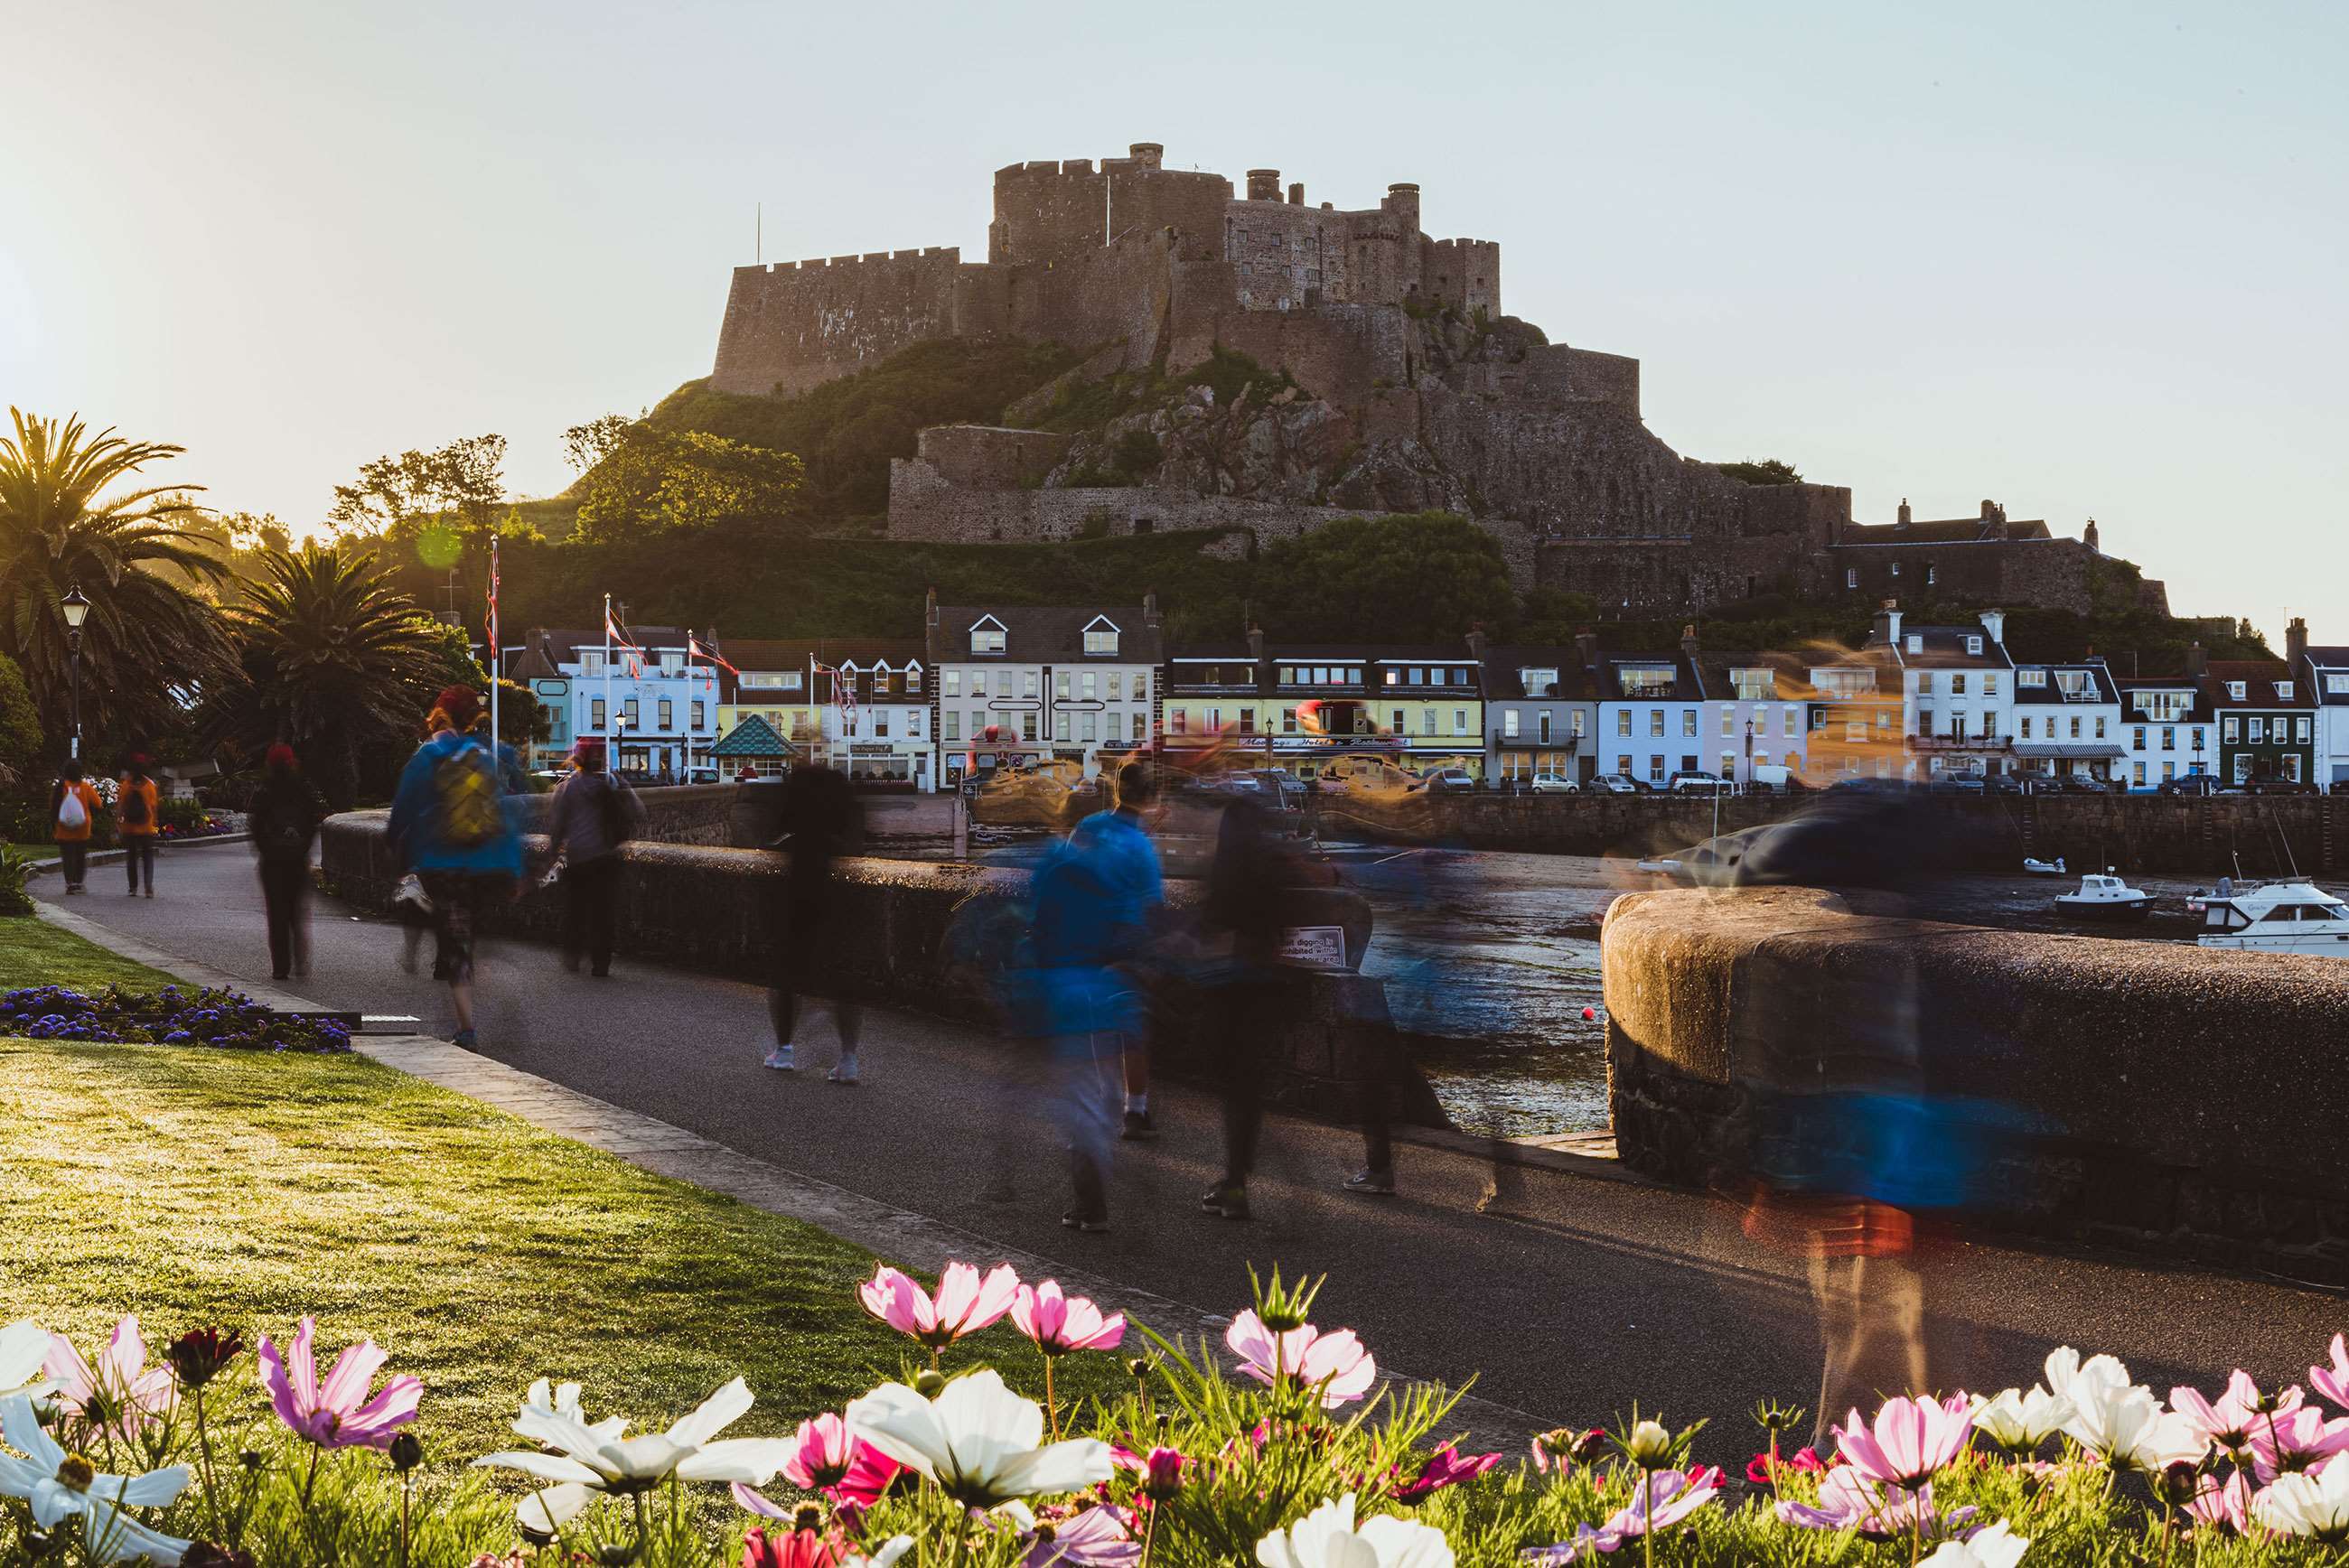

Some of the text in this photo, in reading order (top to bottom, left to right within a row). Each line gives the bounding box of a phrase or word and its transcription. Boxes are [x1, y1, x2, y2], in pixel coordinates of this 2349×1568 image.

[1242, 738, 1291, 746] Moongs
[1297, 737, 1330, 745] Hotel
[1297, 938, 1324, 947] digging
